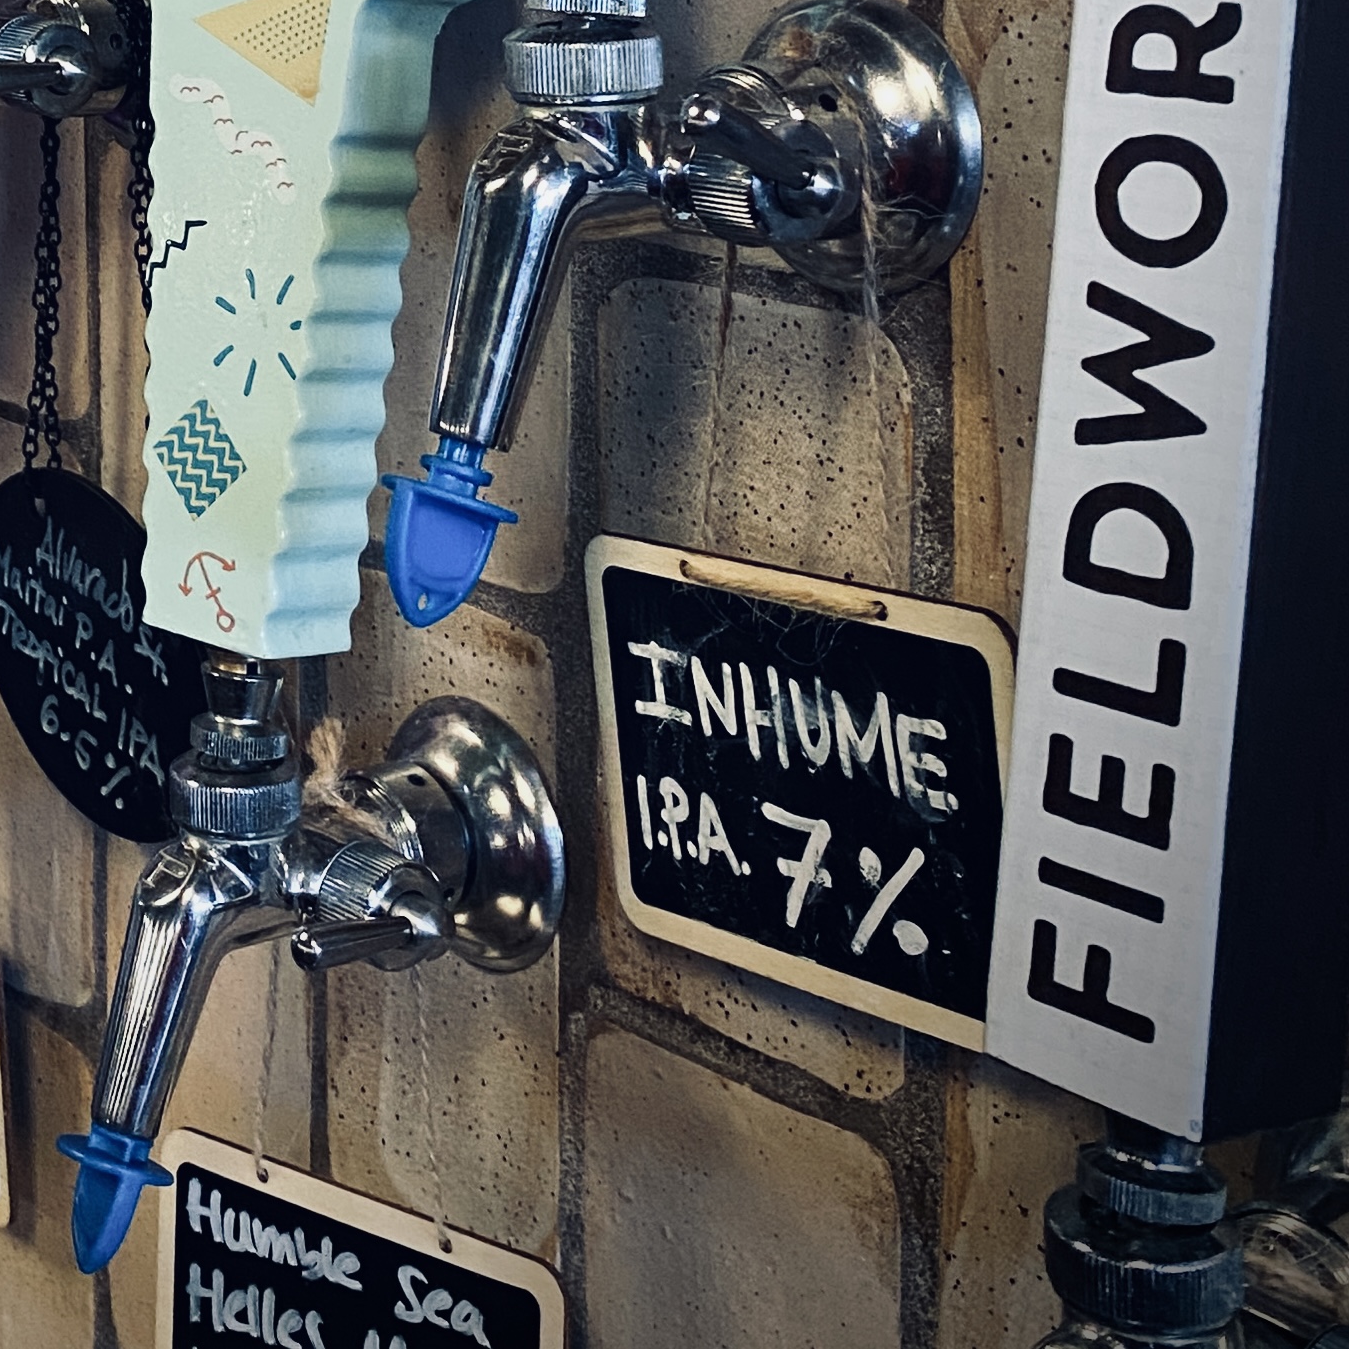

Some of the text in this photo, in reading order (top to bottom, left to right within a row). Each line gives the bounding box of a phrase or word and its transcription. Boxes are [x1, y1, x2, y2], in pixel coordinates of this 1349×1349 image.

[118, 707, 166, 787] IPA
[627, 640, 959, 814] INHUME
[186, 1176, 492, 1348] Humble Sea
